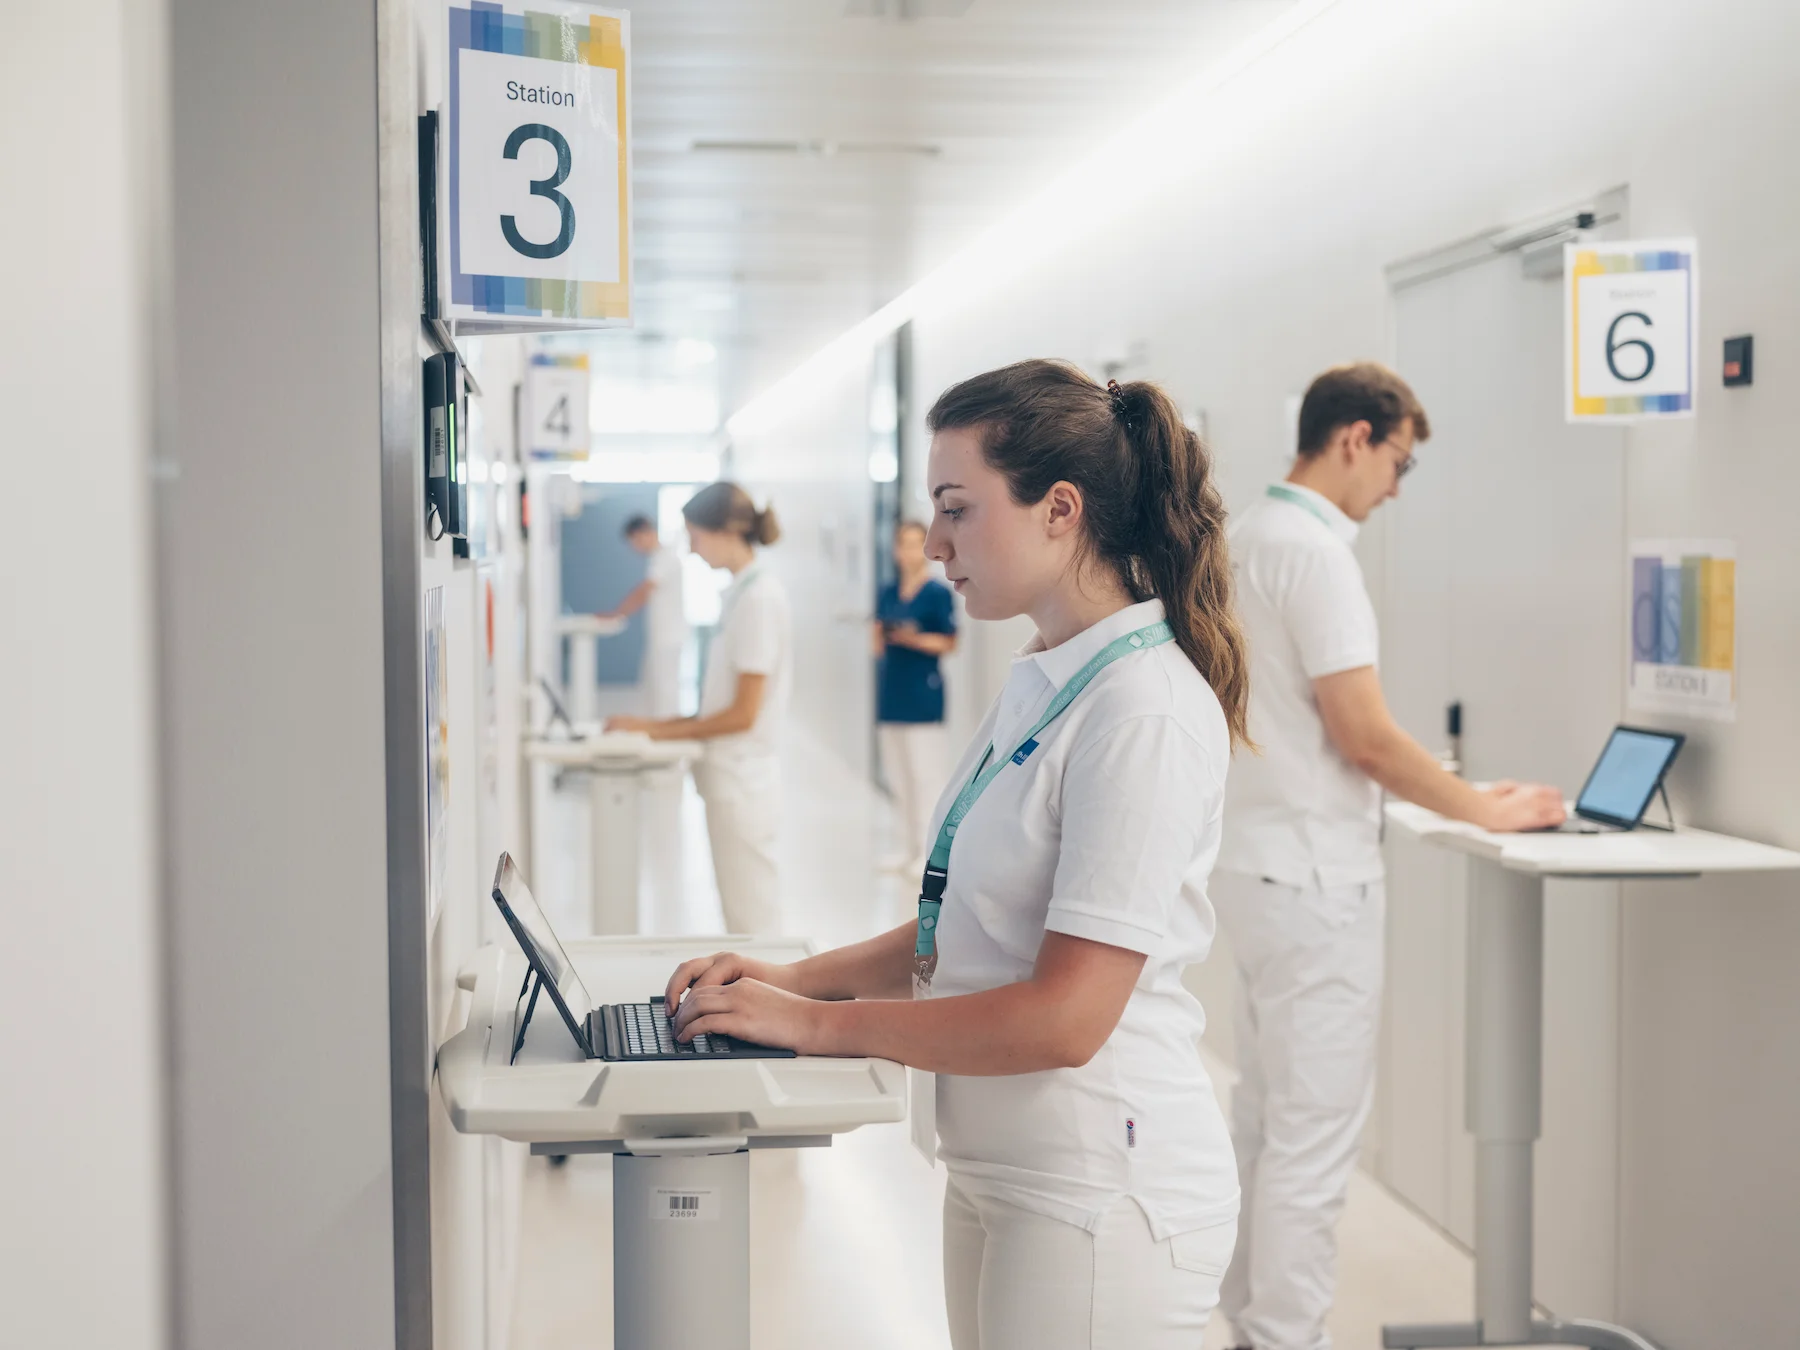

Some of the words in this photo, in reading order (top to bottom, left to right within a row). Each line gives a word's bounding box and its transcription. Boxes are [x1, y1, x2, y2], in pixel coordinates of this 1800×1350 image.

[506, 80, 575, 108] Station
[500, 123, 576, 259] 3
[1605, 311, 1655, 382] 6
[543, 394, 573, 441] 4
[1071, 647, 1116, 692] simulation
[670, 1210, 697, 1218] 23699
